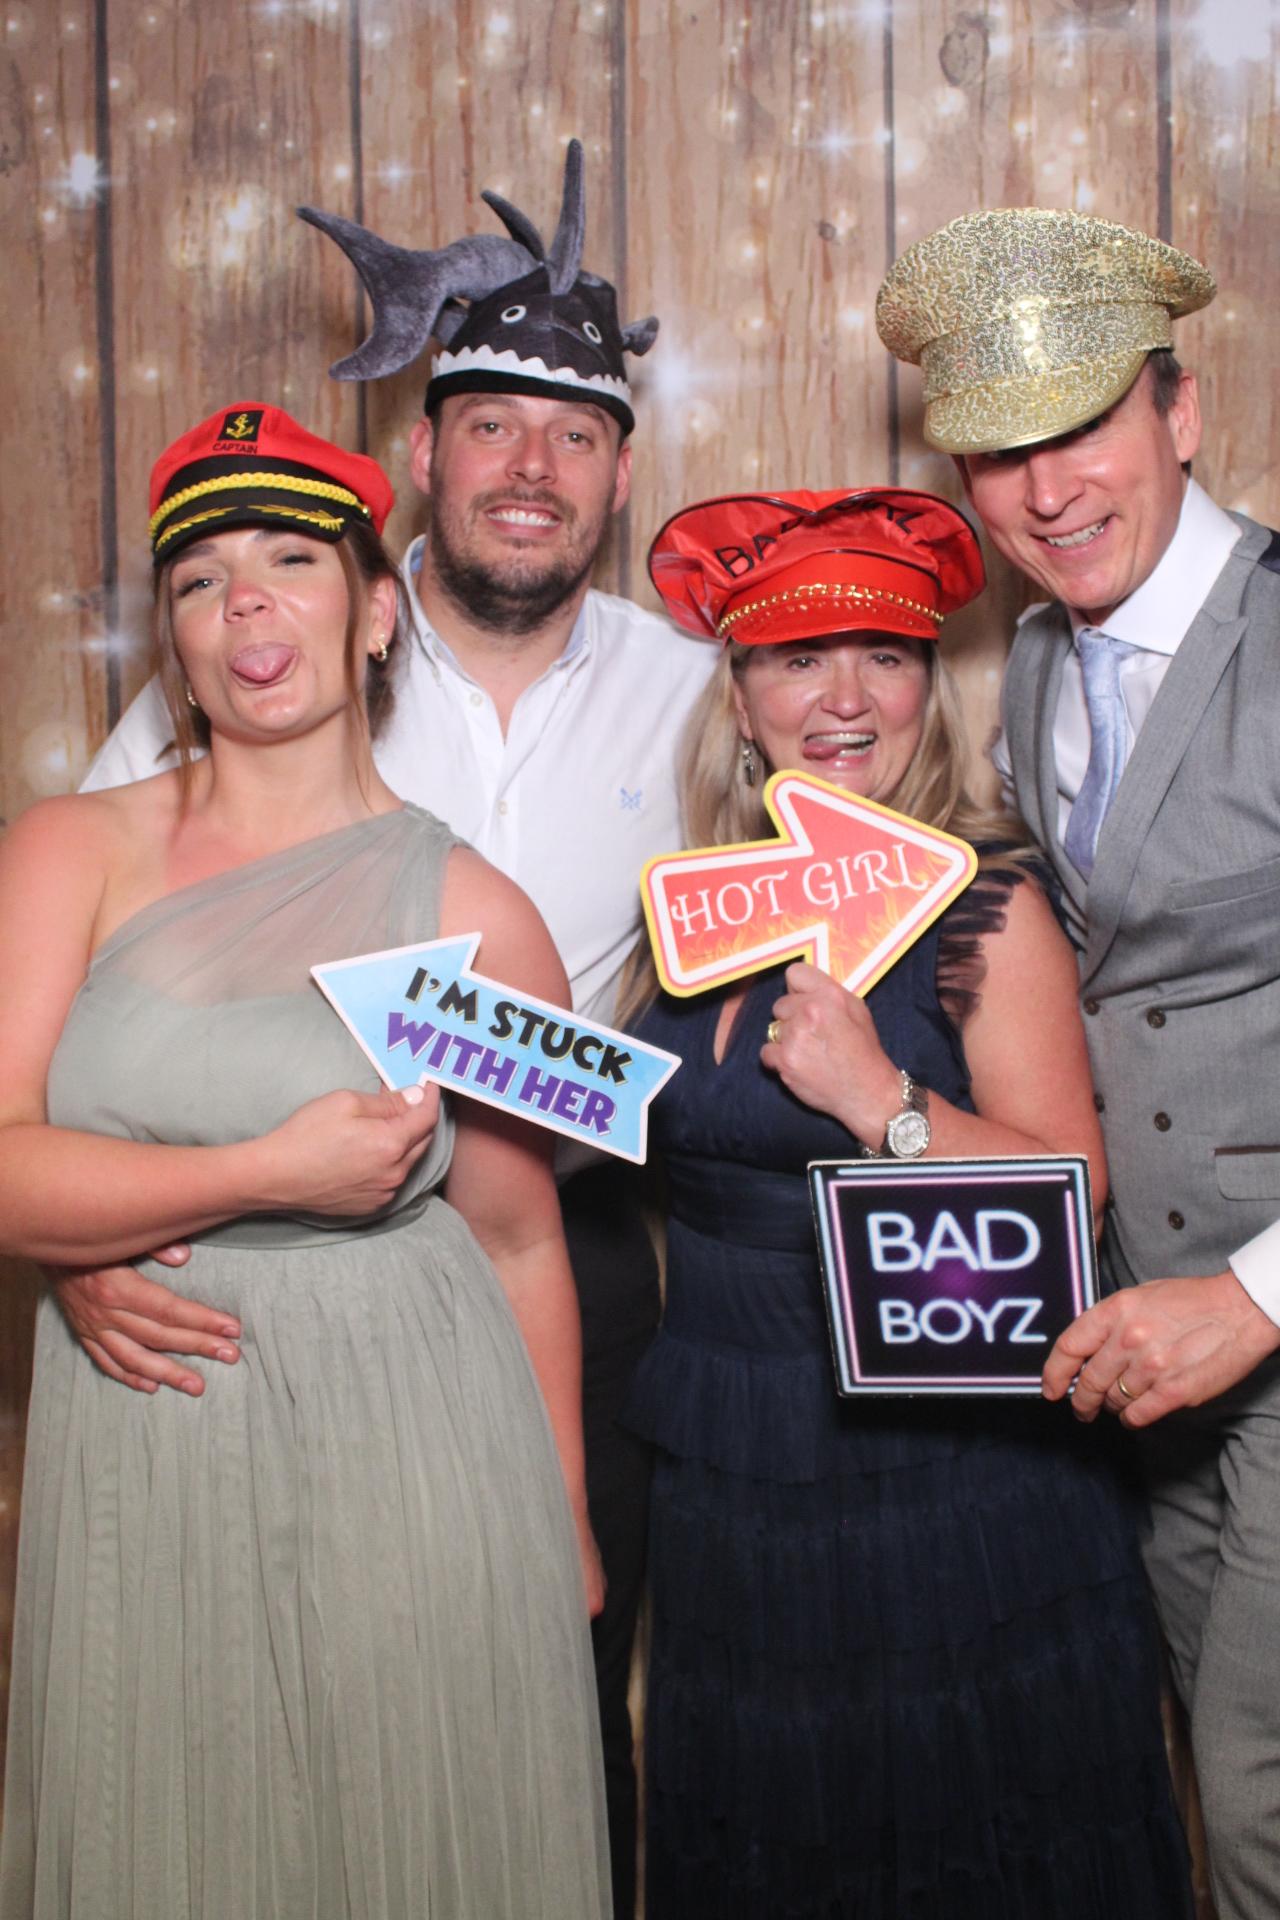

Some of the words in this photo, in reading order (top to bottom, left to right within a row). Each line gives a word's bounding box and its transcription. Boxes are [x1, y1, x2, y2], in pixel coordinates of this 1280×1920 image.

[211, 442, 259, 454] CAPTAIN
[670, 870, 789, 937] HOT
[802, 843, 929, 912] GIRL
[405, 966, 478, 1024] I'M
[488, 1001, 632, 1086] STUCK
[387, 1012, 518, 1097] WITH
[518, 1065, 617, 1136] HER
[867, 1209, 1041, 1272] BAD
[879, 1298, 1048, 1344] BOYZ
